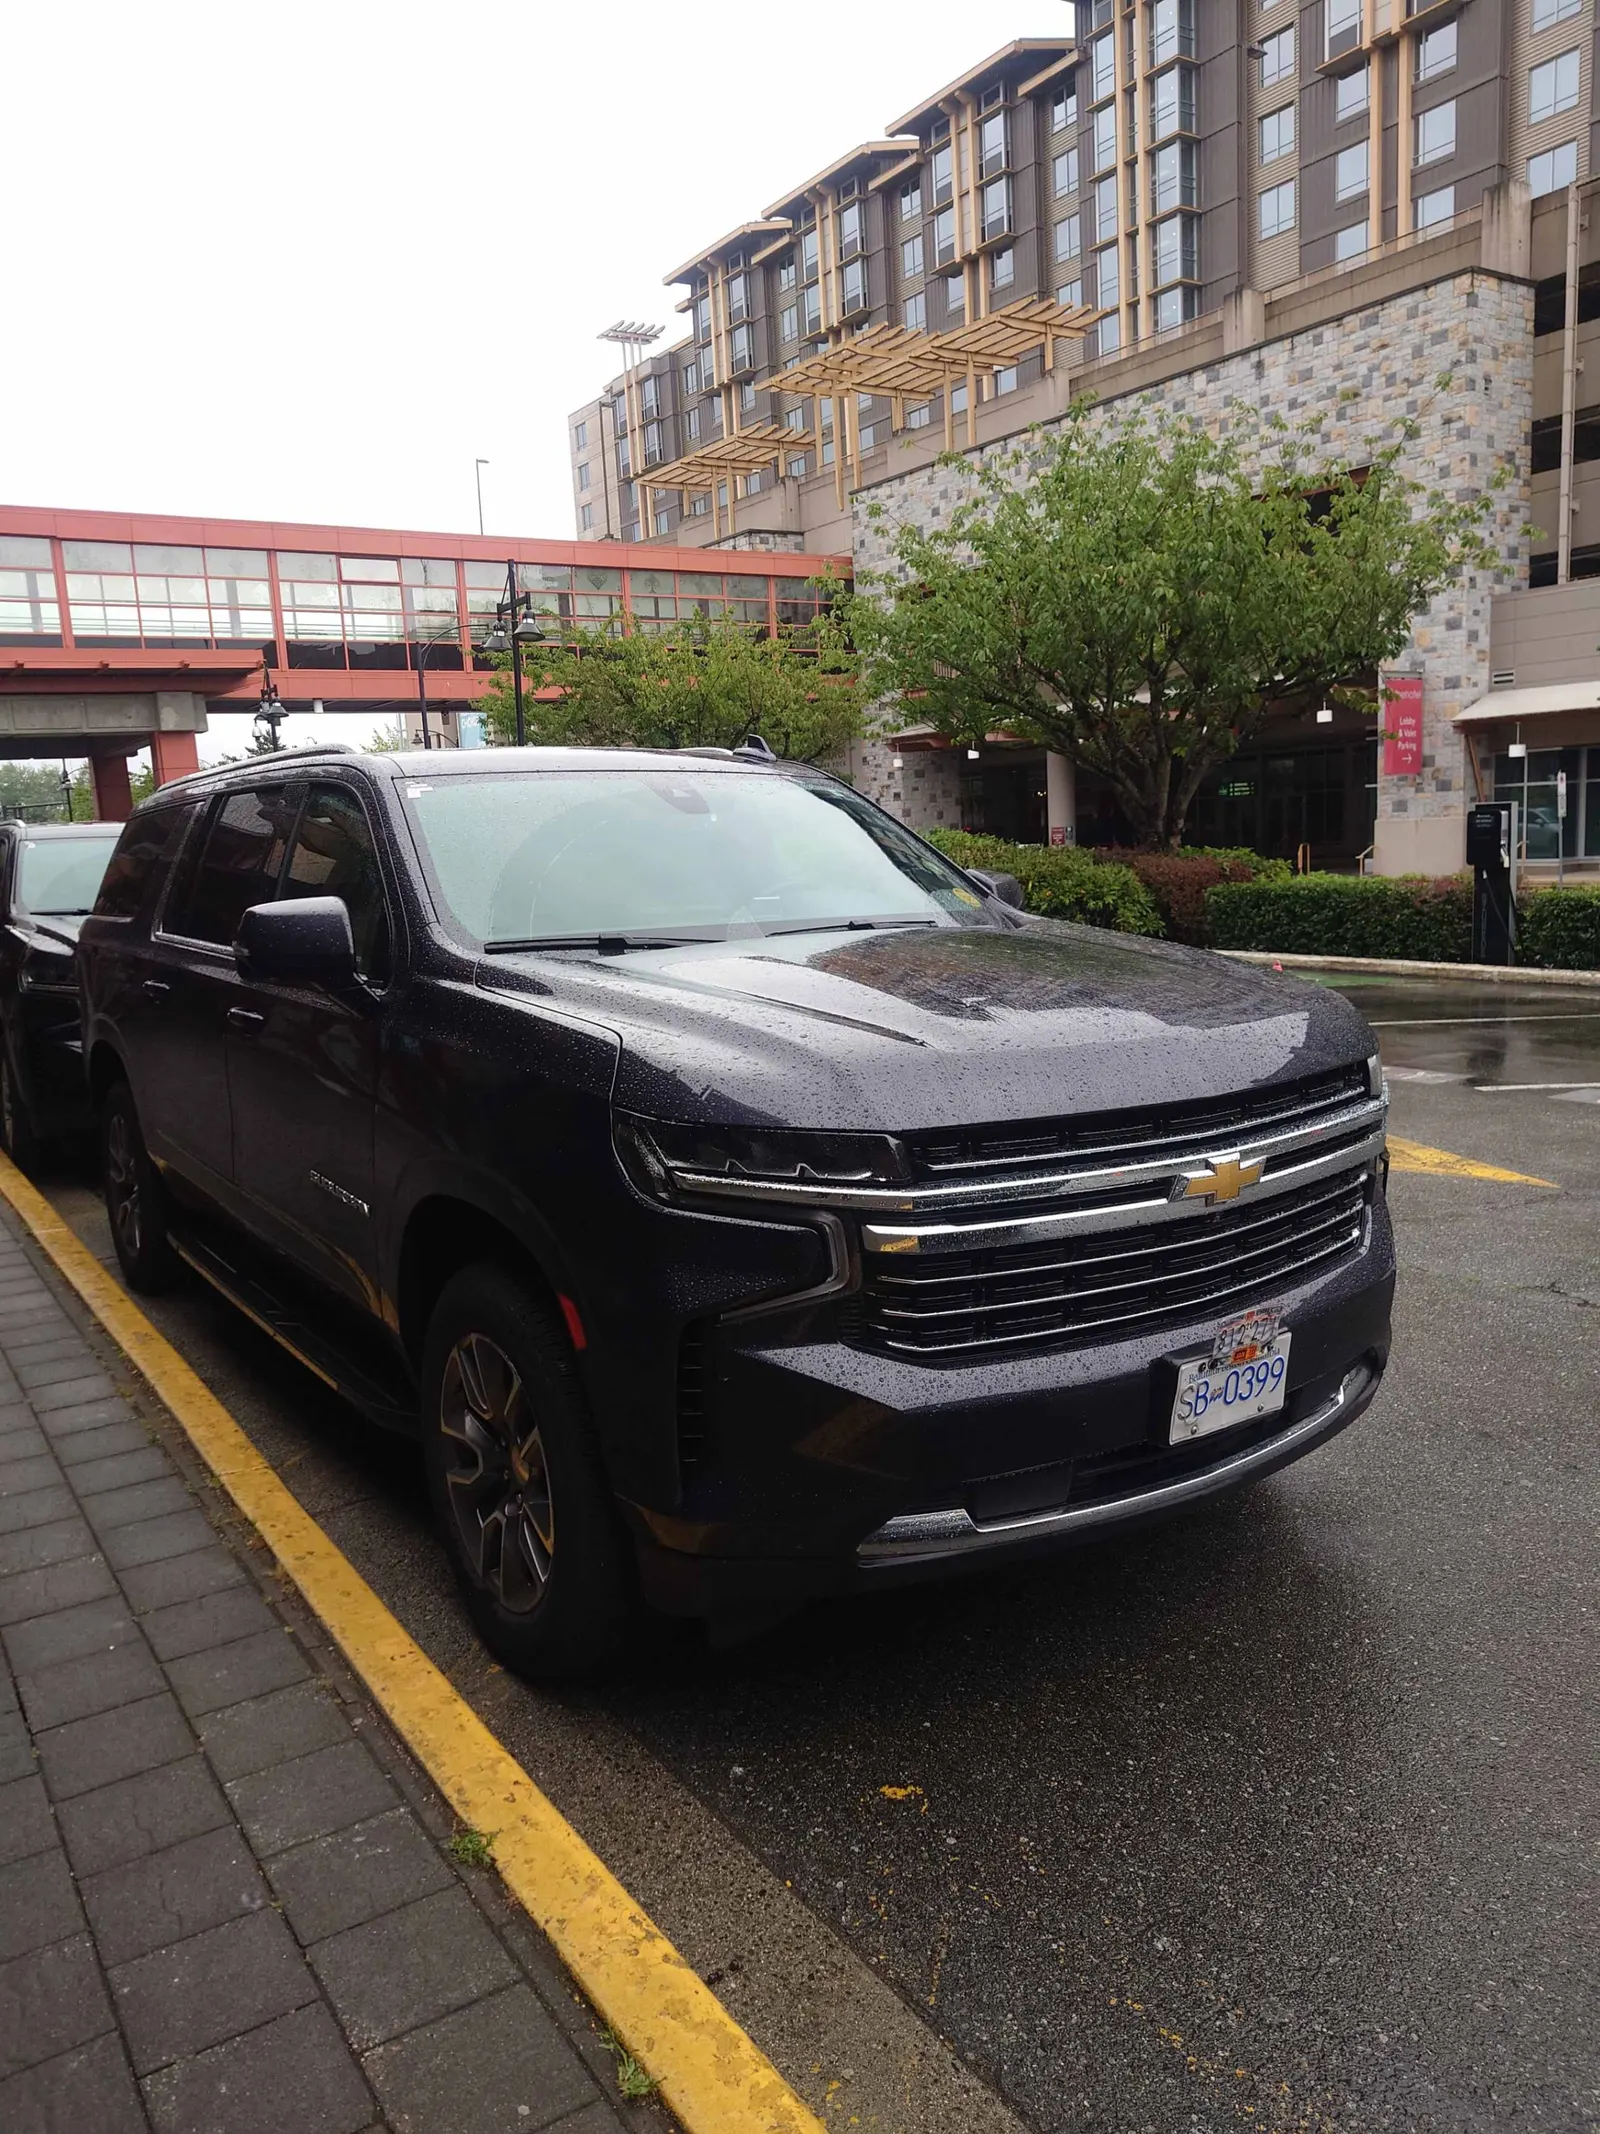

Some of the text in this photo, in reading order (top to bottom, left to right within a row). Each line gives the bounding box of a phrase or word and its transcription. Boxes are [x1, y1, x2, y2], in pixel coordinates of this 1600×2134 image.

[1399, 716, 1416, 726] Lobby
[1403, 728, 1417, 738] Valet
[1397, 741, 1417, 752] Parking
[1177, 1355, 1285, 1419] SB 0399
